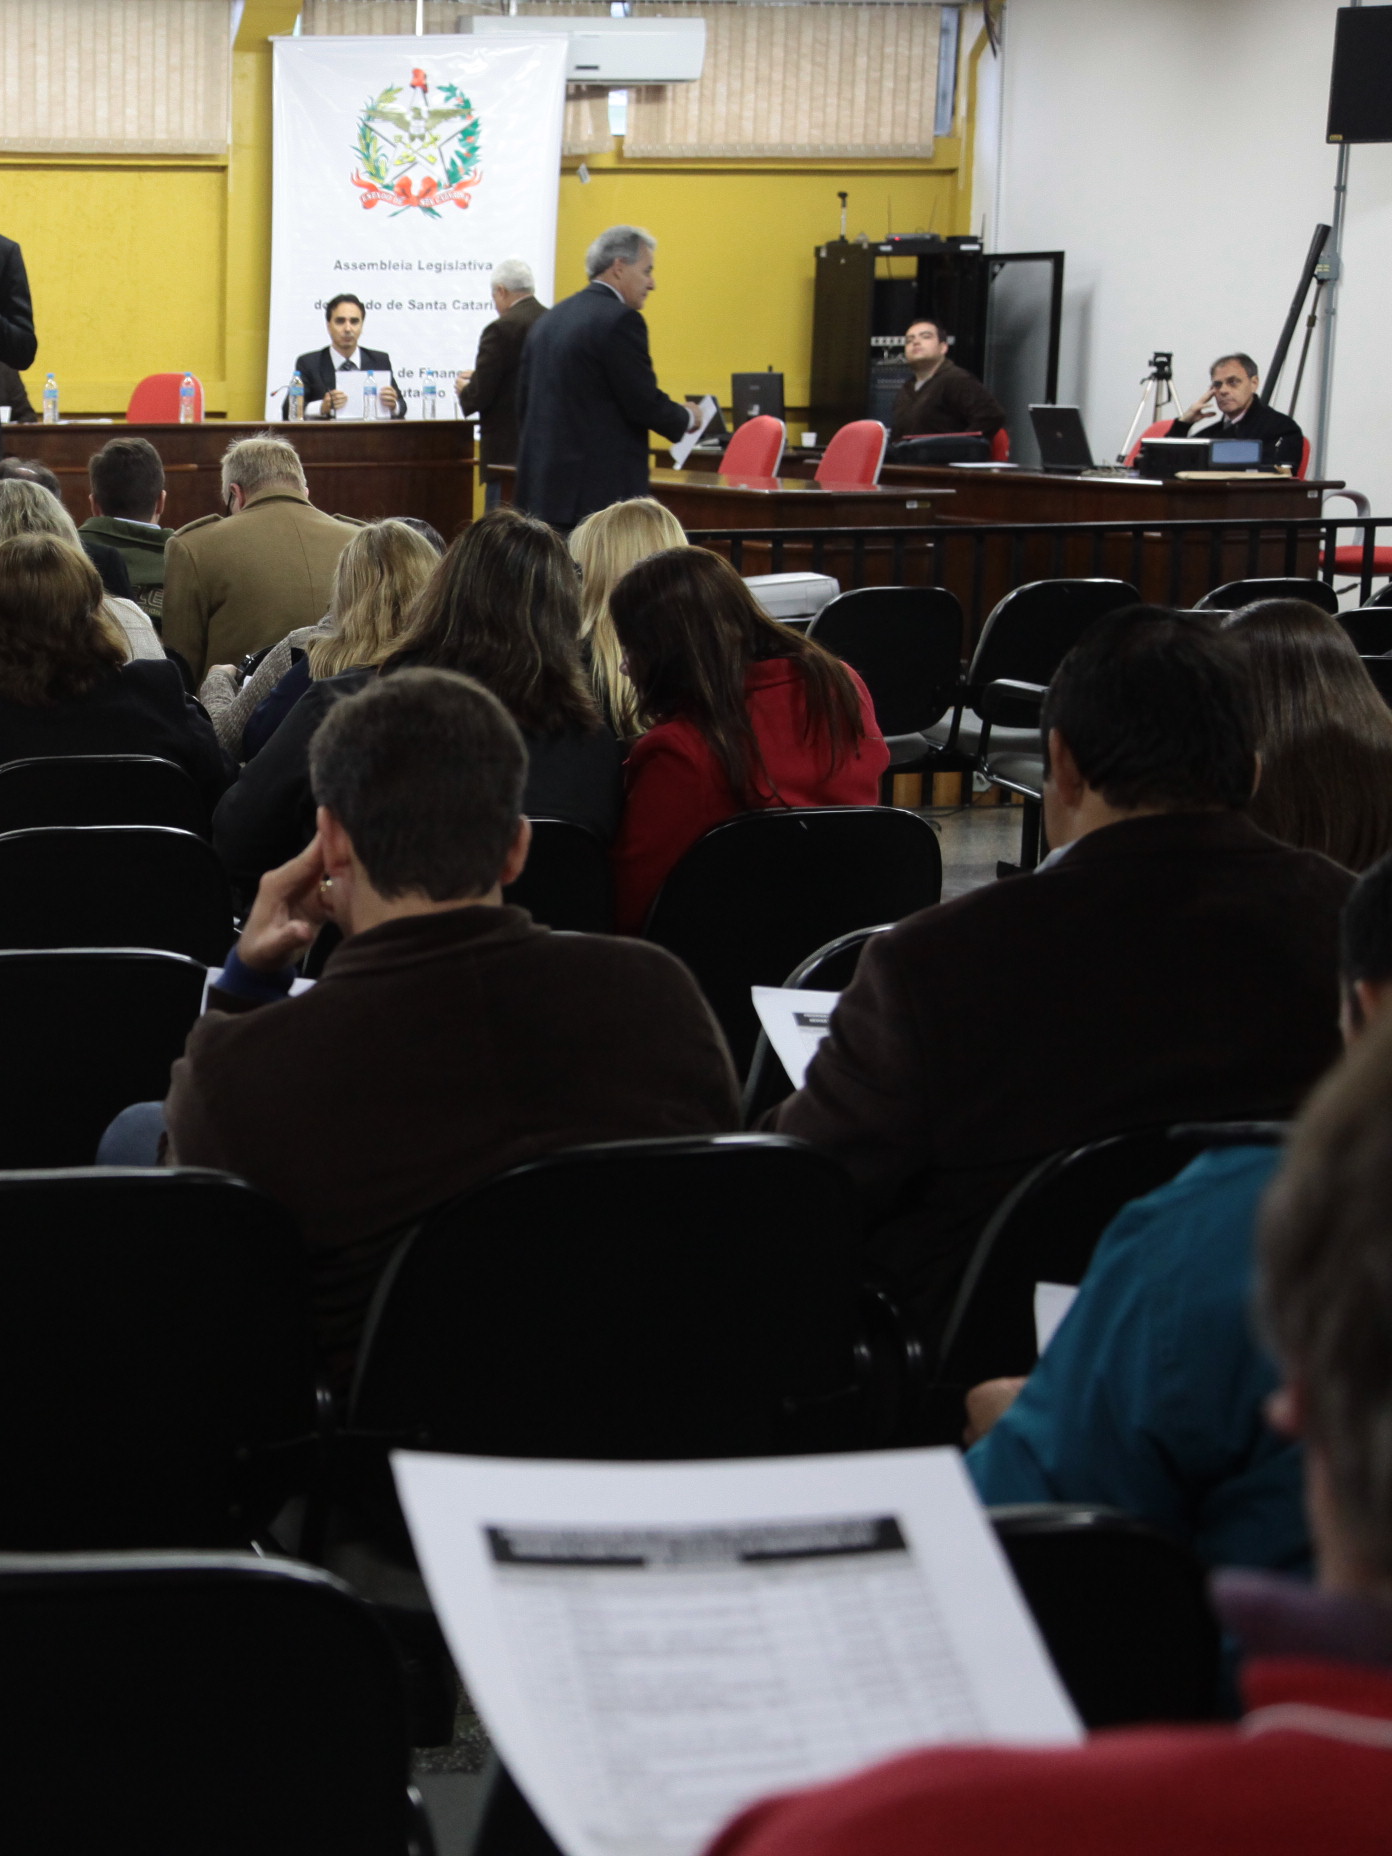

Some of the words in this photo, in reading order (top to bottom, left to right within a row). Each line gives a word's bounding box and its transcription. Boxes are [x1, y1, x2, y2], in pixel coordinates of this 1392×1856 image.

[333, 260, 413, 271] Assembleia
[417, 259, 493, 273] Legislativa
[386, 299, 403, 310] de
[408, 299, 447, 311] Santa
[397, 367, 414, 378] de
